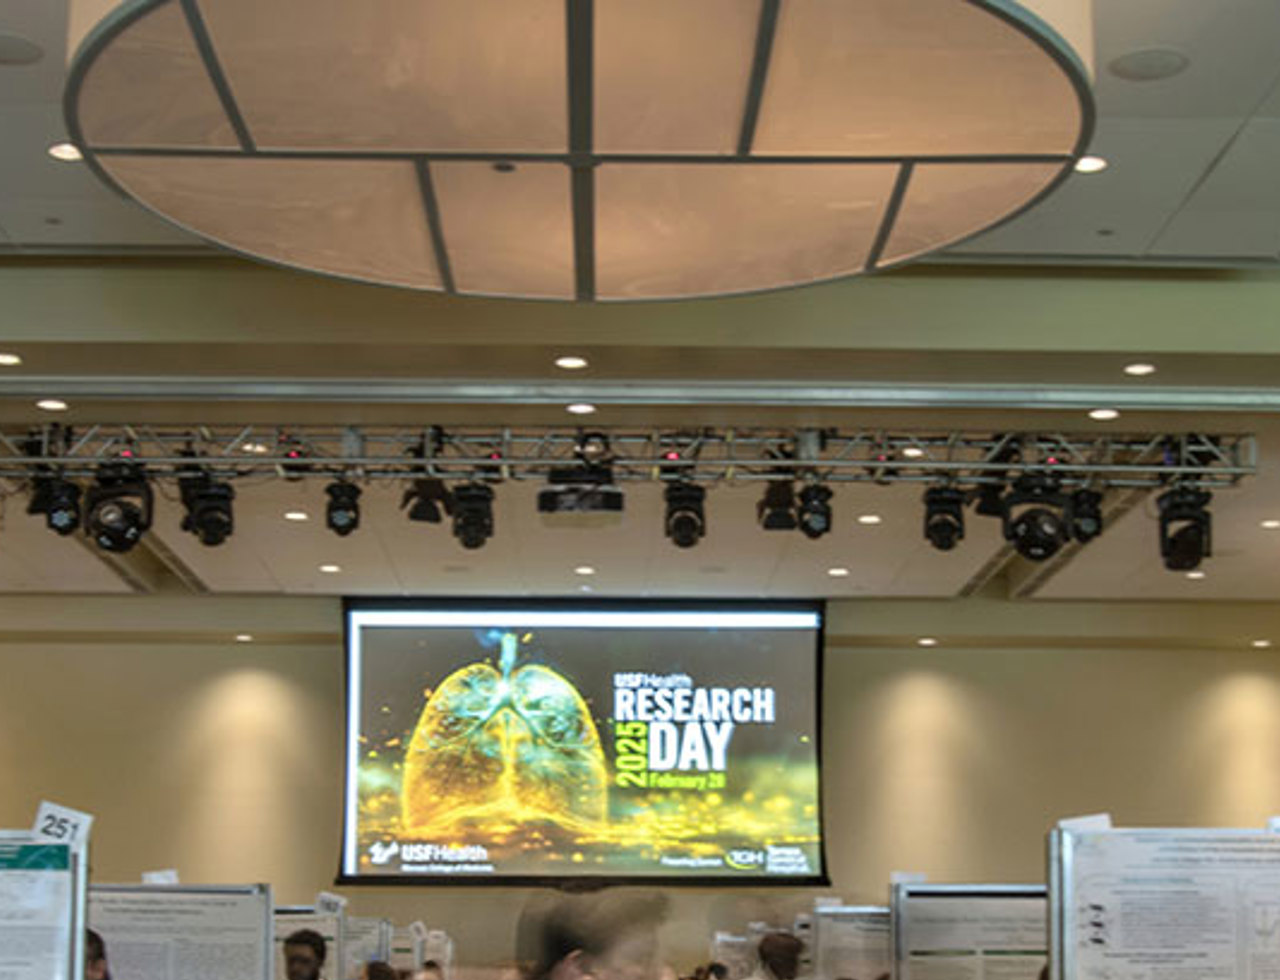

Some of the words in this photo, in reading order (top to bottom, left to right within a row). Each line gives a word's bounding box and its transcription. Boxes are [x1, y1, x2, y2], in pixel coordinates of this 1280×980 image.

[614, 688, 775, 722] RESEARCH
[615, 722, 647, 787] 2025
[649, 722, 735, 771] DAY
[40, 813, 80, 843] 251
